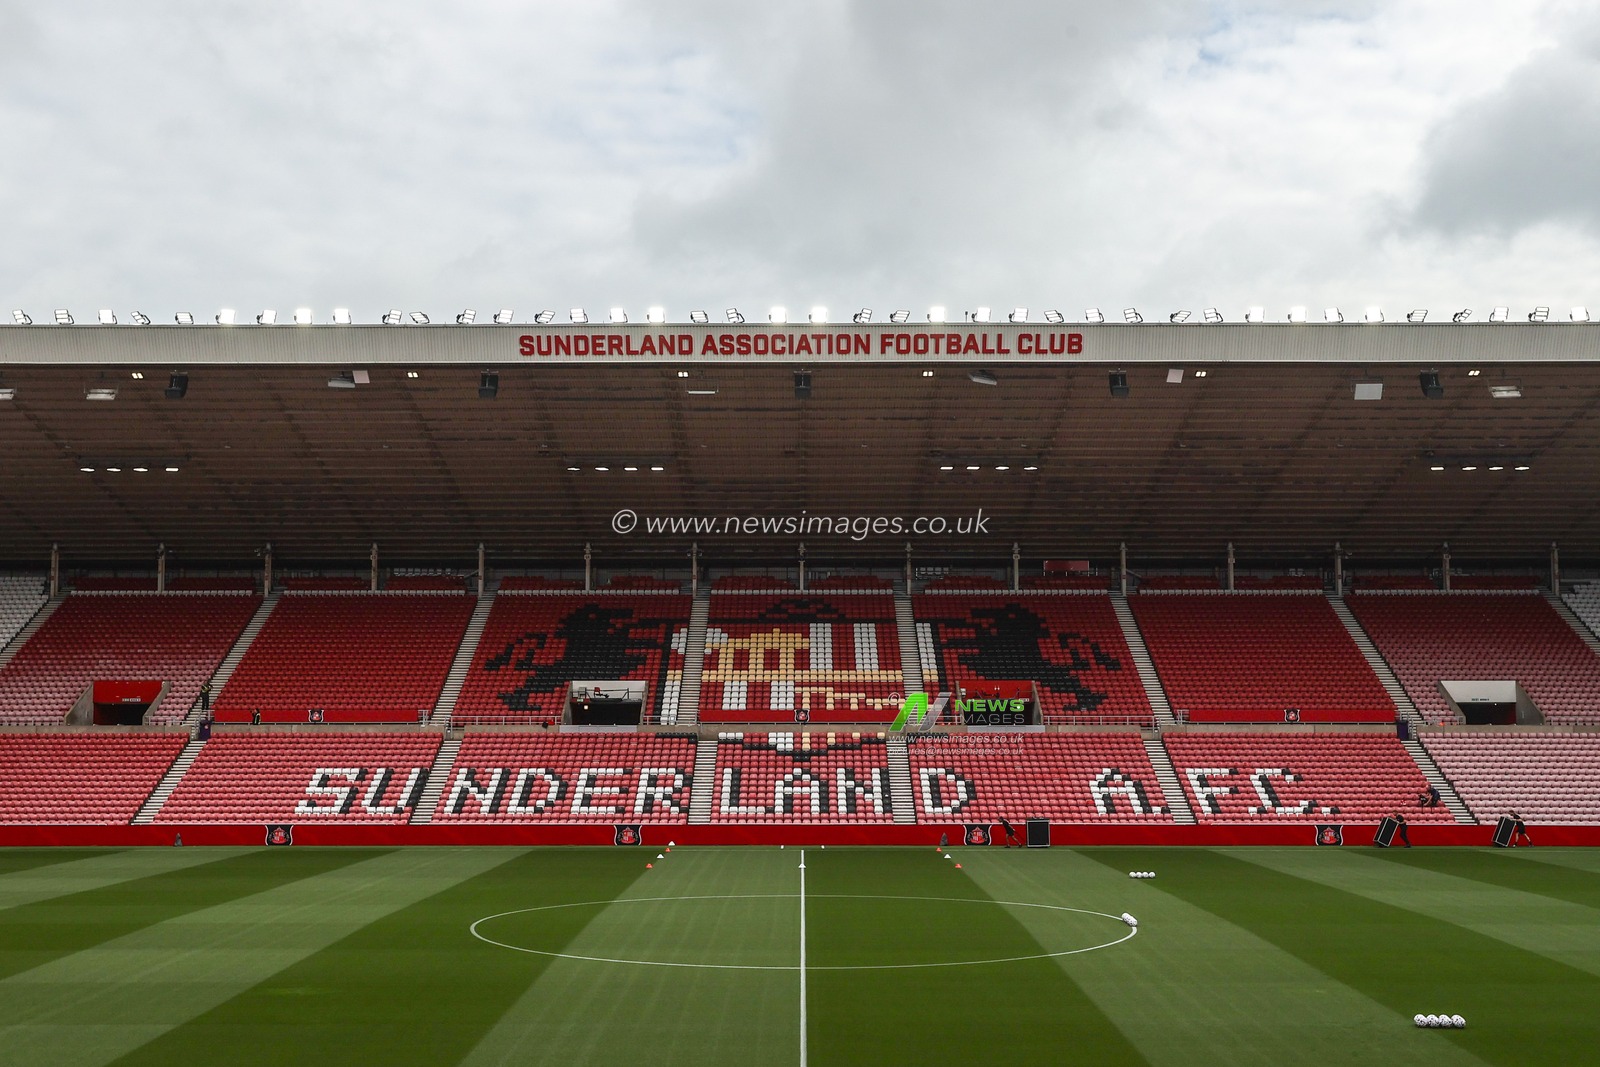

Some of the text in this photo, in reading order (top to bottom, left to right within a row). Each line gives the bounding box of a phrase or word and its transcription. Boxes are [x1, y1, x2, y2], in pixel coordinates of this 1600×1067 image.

[519, 333, 1083, 356] SUNDERLAND ASSOCIATION FOOTBALL CLUB
